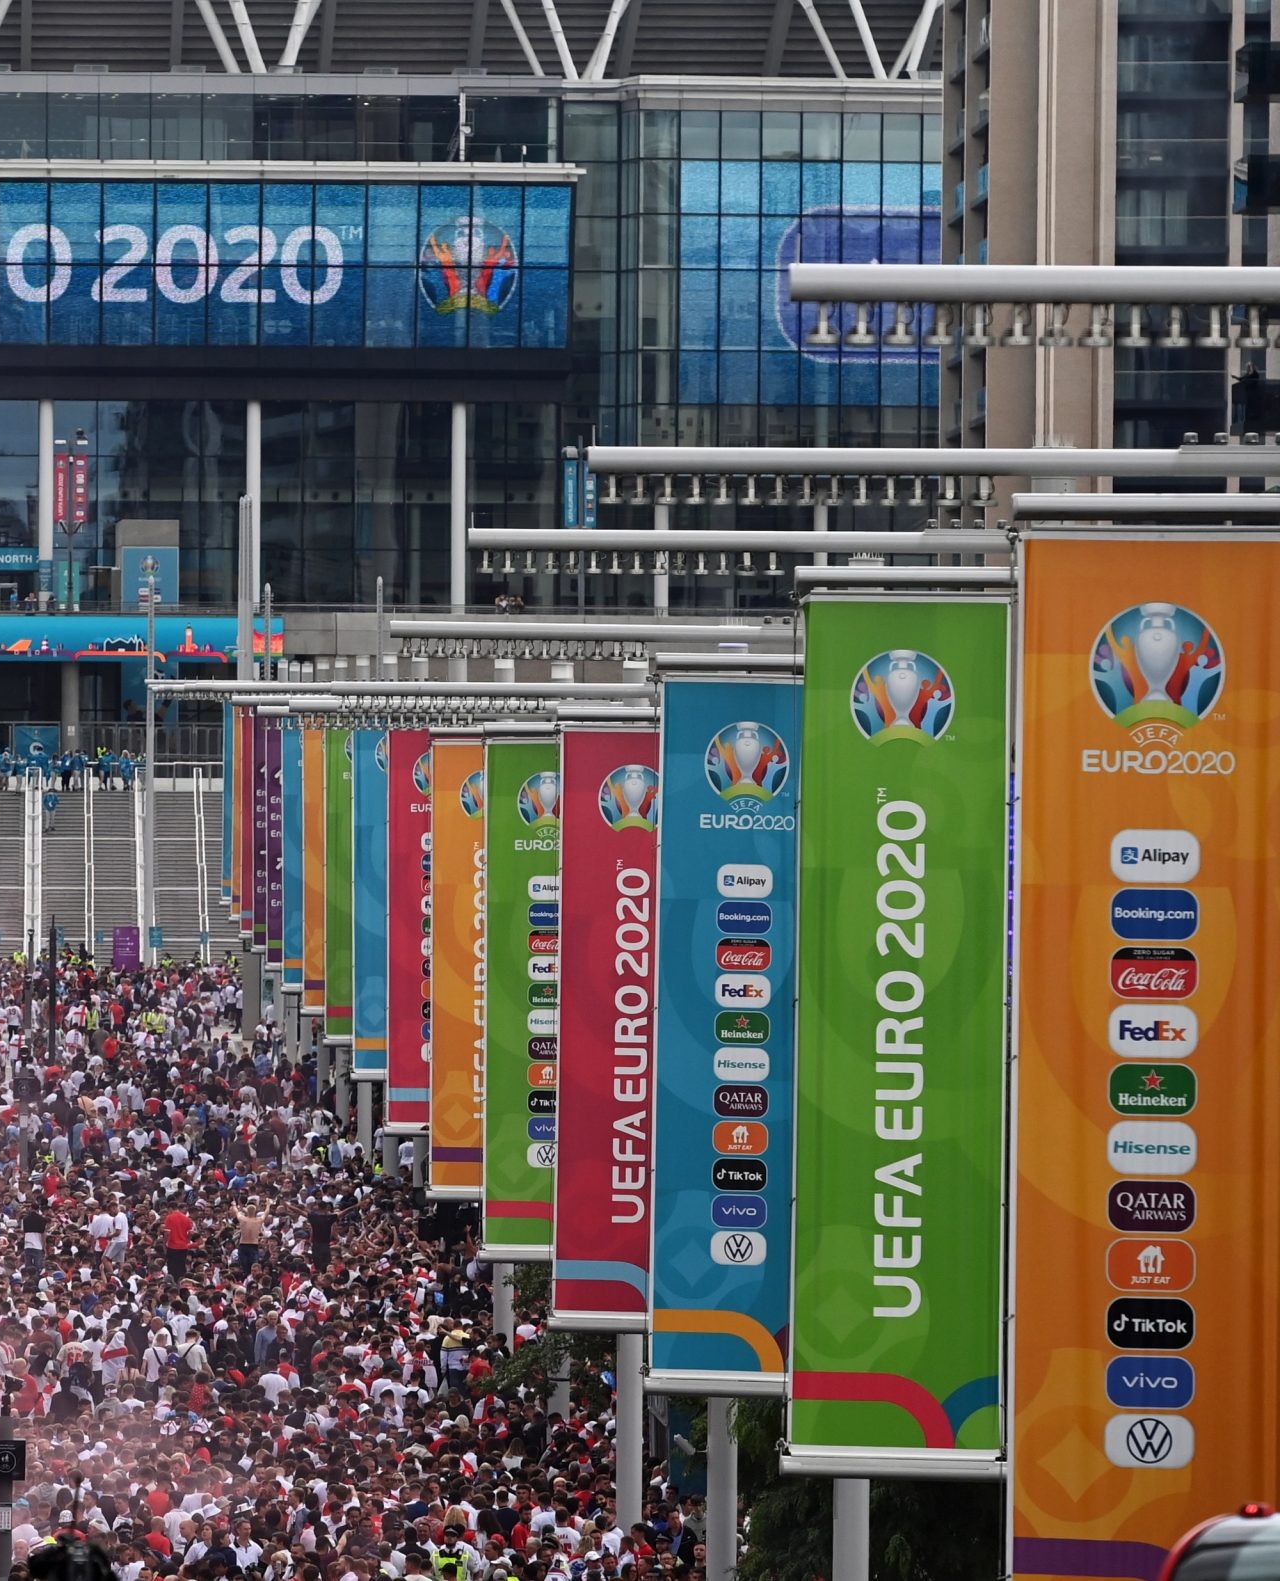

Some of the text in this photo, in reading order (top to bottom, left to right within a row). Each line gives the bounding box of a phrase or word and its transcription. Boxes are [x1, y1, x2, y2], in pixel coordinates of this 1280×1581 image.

[91, 223, 344, 305] 2020
[1132, 727, 1179, 745] UEFA
[1082, 749, 1236, 774] EURO2020
[731, 801, 760, 811] UEFA
[699, 813, 795, 831] EURO2020
[1141, 848, 1190, 864] Alipay
[736, 876, 766, 887] Alipay
[876, 800, 926, 958] 2020
[542, 884, 559, 892] Alipa
[719, 913, 769, 922] Booking.com
[1114, 907, 1195, 921] Booking.com
[615, 867, 650, 978] 2020
[532, 963, 558, 973] FedE
[721, 984, 764, 998] FedEx
[721, 1029, 764, 1039] Heineken
[1119, 1020, 1186, 1041] FedEx
[531, 1041, 557, 1052] QATA
[614, 984, 649, 1102] EURO
[875, 970, 924, 1140] EURO
[717, 1060, 765, 1069] Hisense
[719, 1092, 762, 1104] QATAR
[1118, 1093, 1187, 1107] Heineken
[729, 1103, 763, 1111] AIRWAYS
[1113, 1141, 1191, 1155] Hisense
[611, 1110, 646, 1223] UEFA
[728, 1170, 762, 1181] TikTok
[1116, 1191, 1185, 1211] QATAR
[722, 1205, 757, 1216] vivo
[1133, 1210, 1186, 1220] AIRWAYS
[873, 1153, 922, 1317] UEFA
[1131, 1275, 1171, 1285] JUST EAT
[1132, 1318, 1188, 1333] TikTok
[1122, 1372, 1178, 1389] vivo
